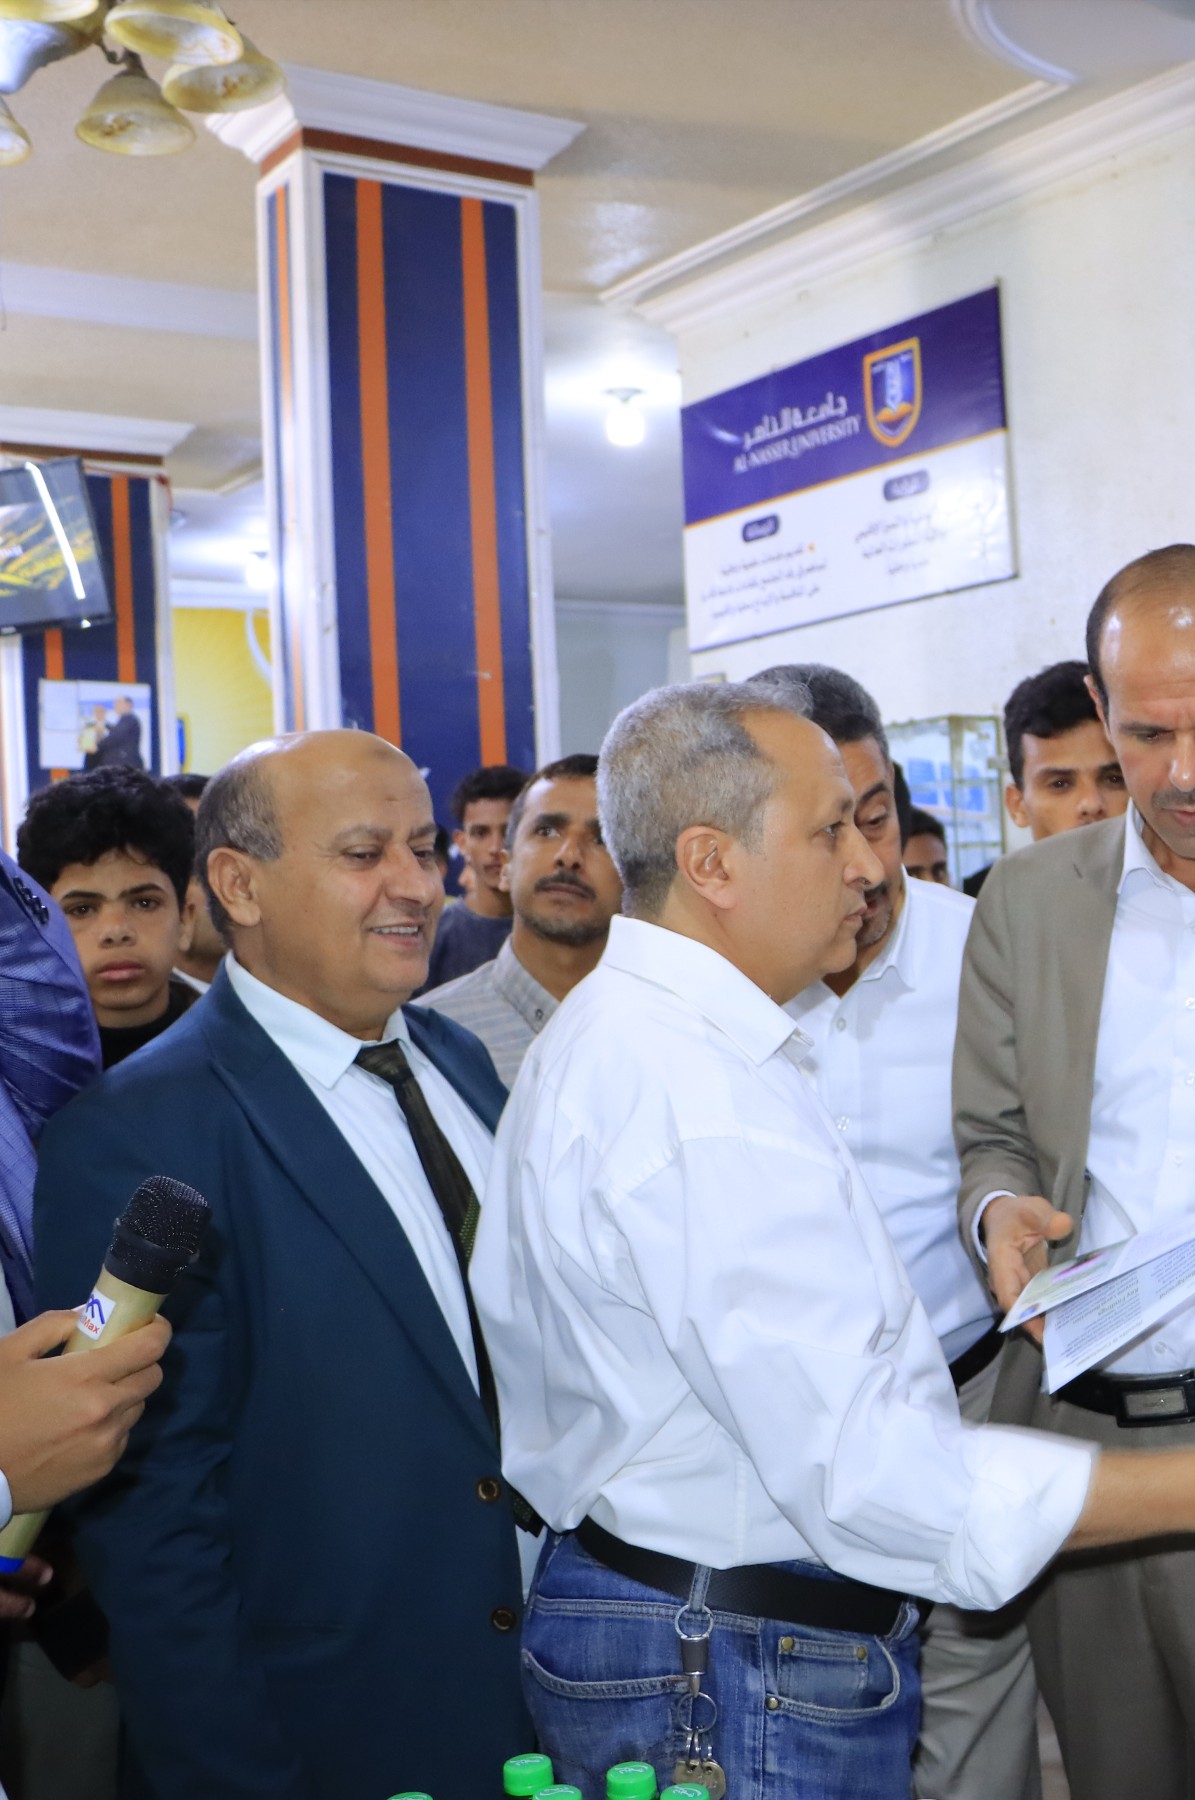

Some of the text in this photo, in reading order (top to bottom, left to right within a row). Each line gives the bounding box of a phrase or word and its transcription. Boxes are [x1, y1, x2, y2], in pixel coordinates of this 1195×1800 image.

[744, 391, 847, 451] جامعة الناصر
[788, 414, 860, 458] UNIVERSITY
[1097, 1296, 1125, 1316] Findings
[80, 1315, 100, 1333] Max
